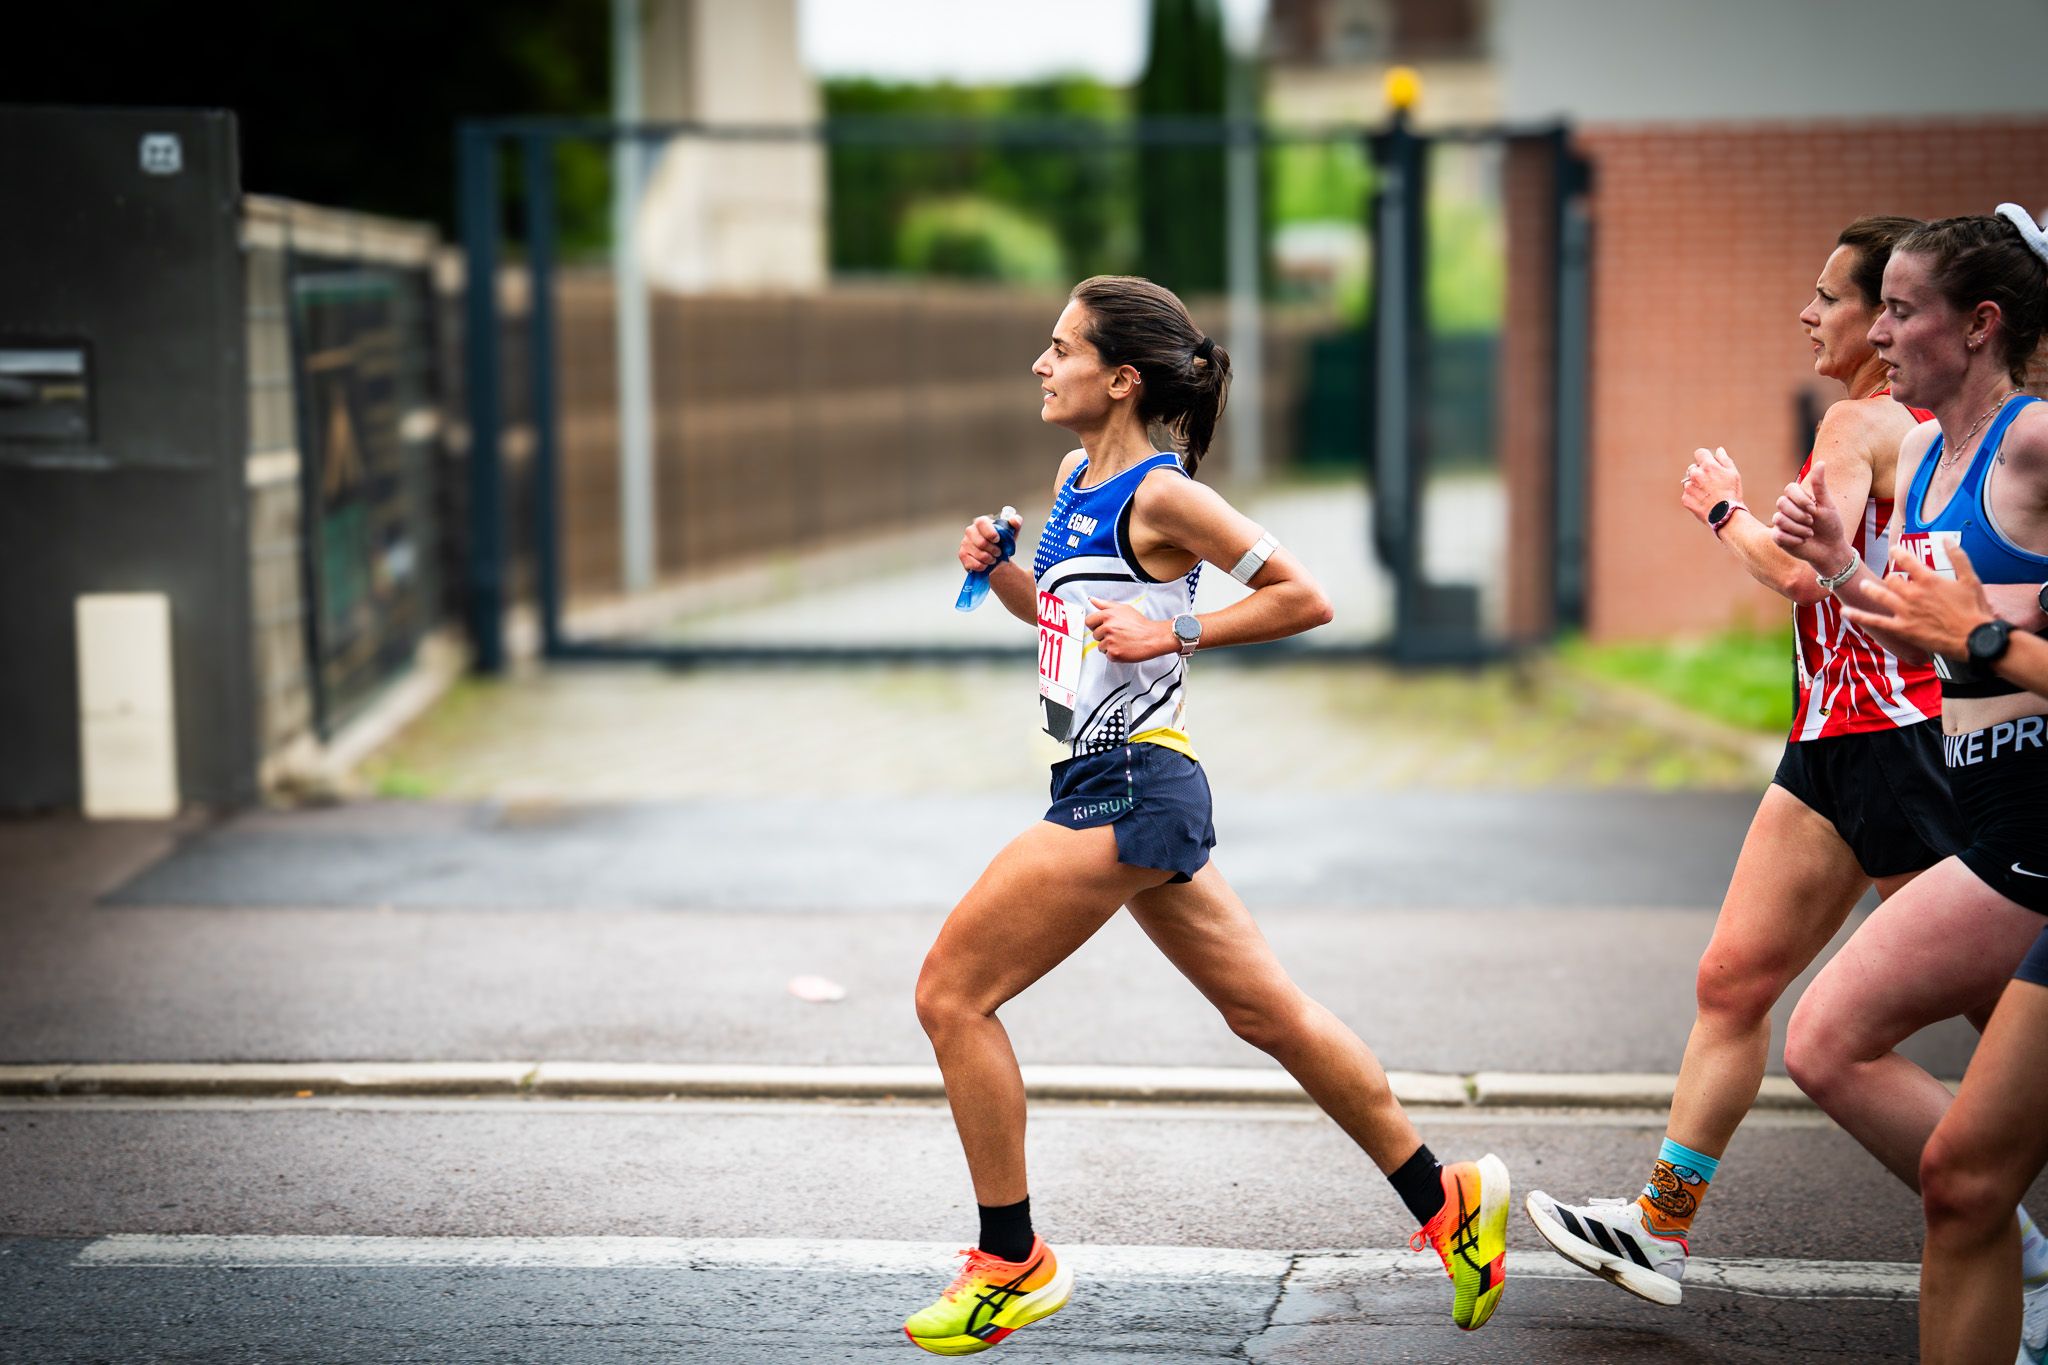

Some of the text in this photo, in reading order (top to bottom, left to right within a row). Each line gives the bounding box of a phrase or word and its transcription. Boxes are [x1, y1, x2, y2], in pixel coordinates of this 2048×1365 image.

[1067, 513, 1098, 536] EGMA
[1040, 629, 1063, 681] 211
[1942, 716, 2048, 768] NIKE PR
[1073, 797, 1134, 820] KIPRUN
